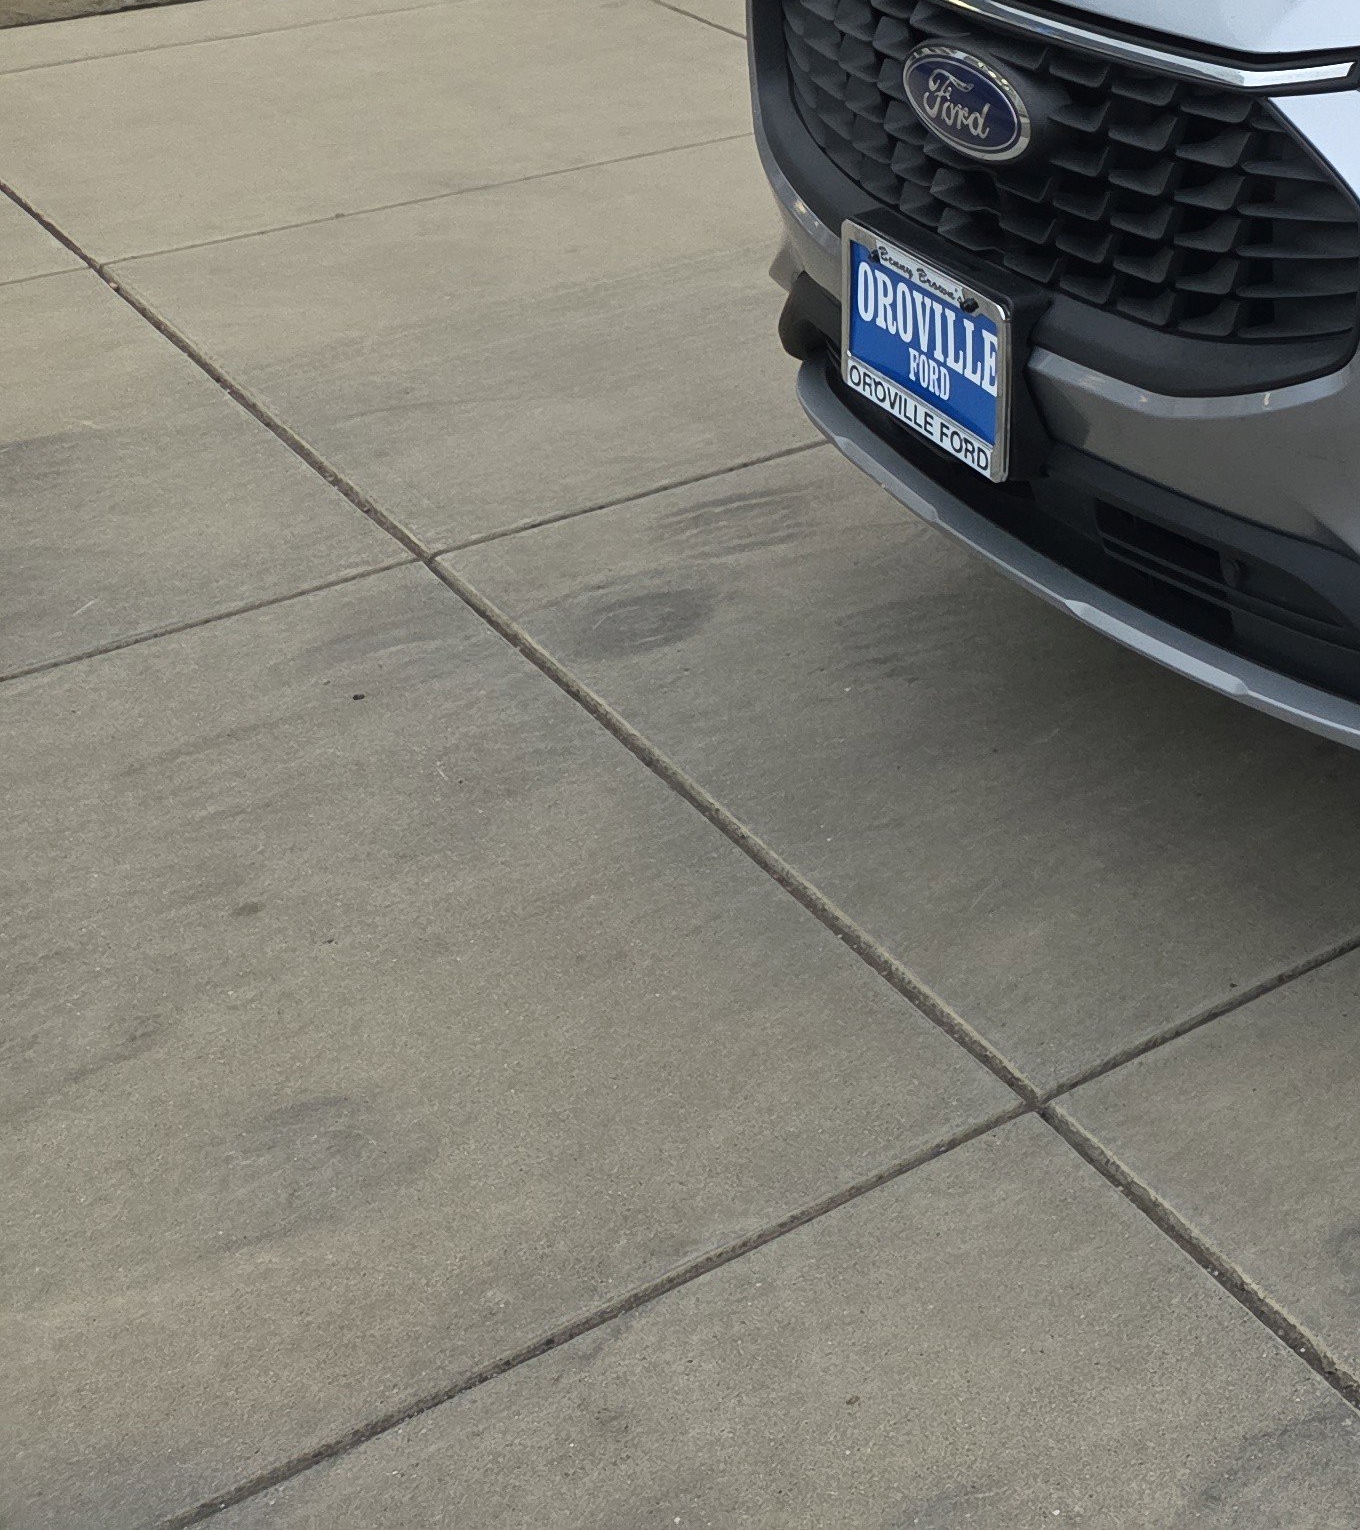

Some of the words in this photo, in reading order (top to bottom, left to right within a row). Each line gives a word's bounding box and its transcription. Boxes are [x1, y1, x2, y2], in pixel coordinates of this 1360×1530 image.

[923, 69, 991, 139] Ford
[857, 261, 998, 398] OROVILLE
[908, 347, 950, 401] FORD
[849, 364, 934, 437] OROVILLE
[939, 421, 989, 472] FORD
